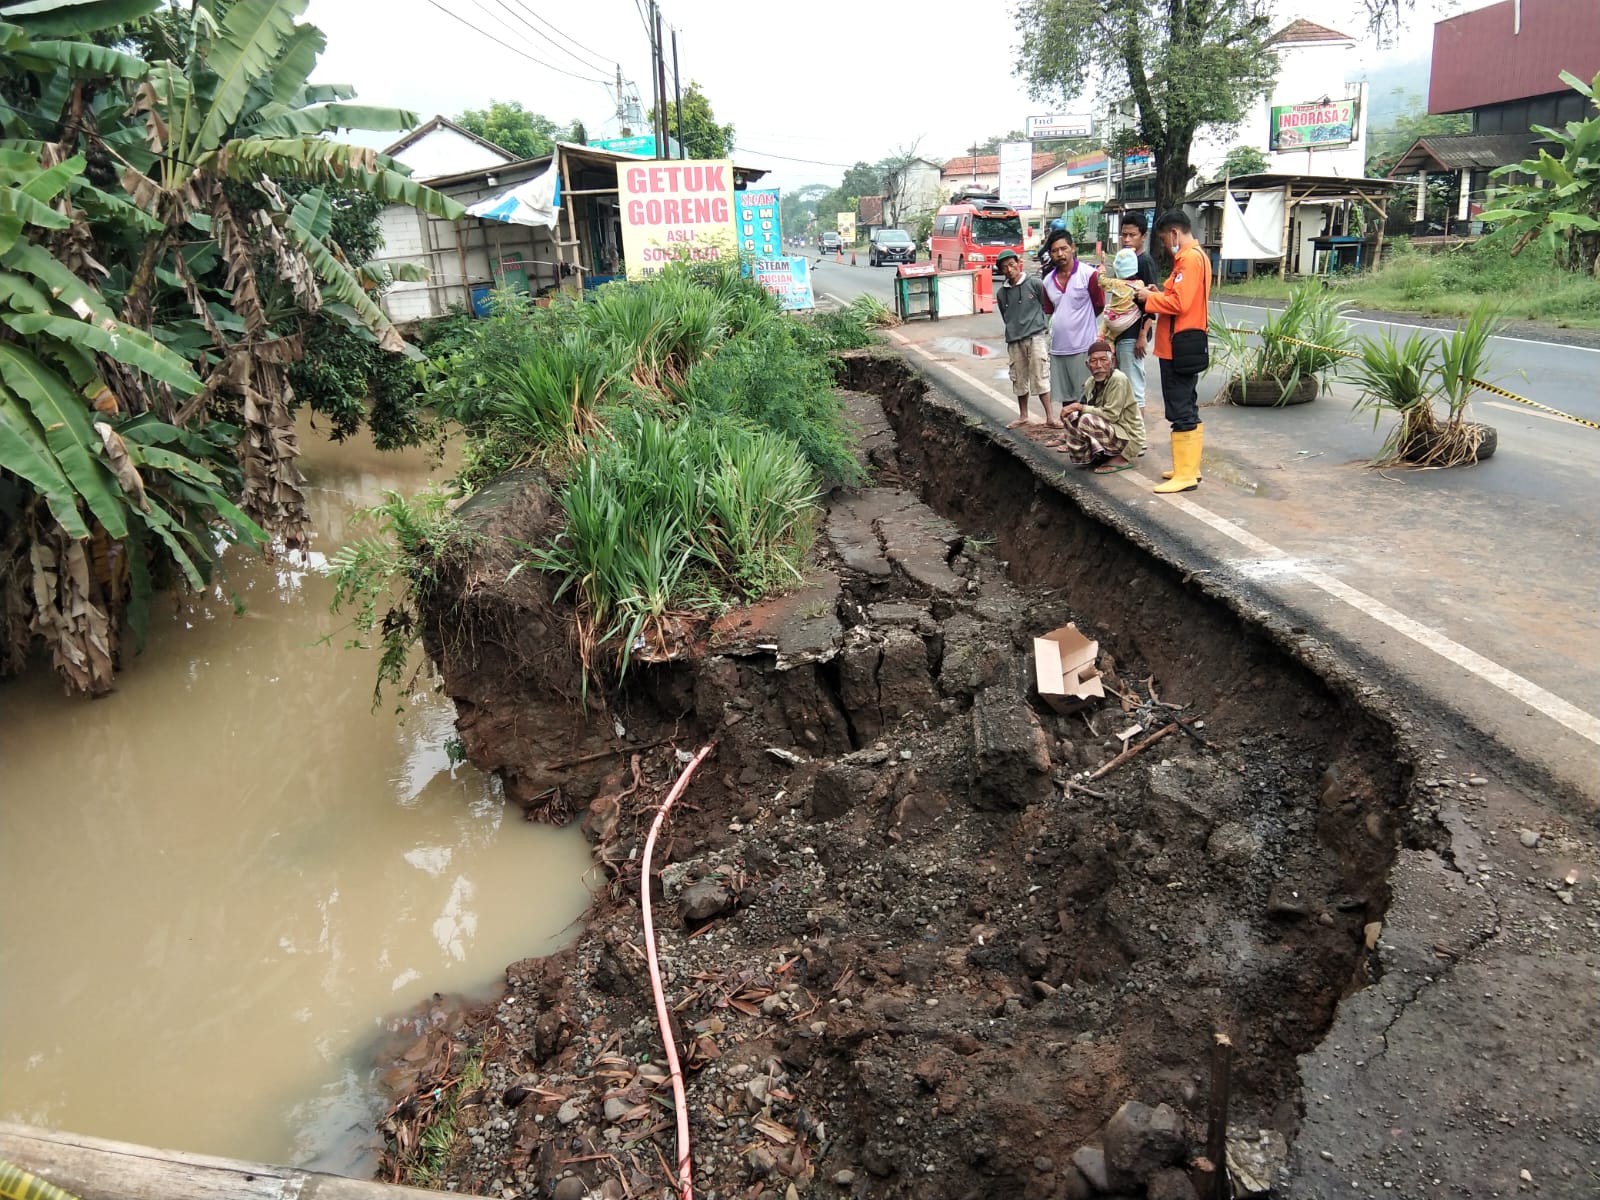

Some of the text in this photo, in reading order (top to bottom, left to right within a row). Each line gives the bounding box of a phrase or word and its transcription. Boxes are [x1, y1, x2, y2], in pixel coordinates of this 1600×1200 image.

[1279, 109, 1349, 128] INDORASA 2
[627, 166, 726, 194] GETUK
[628, 198, 728, 226] GORENG
[667, 230, 694, 242] ASLI
[758, 261, 789, 271] STEAM
[758, 274, 792, 283] CUCIAN
